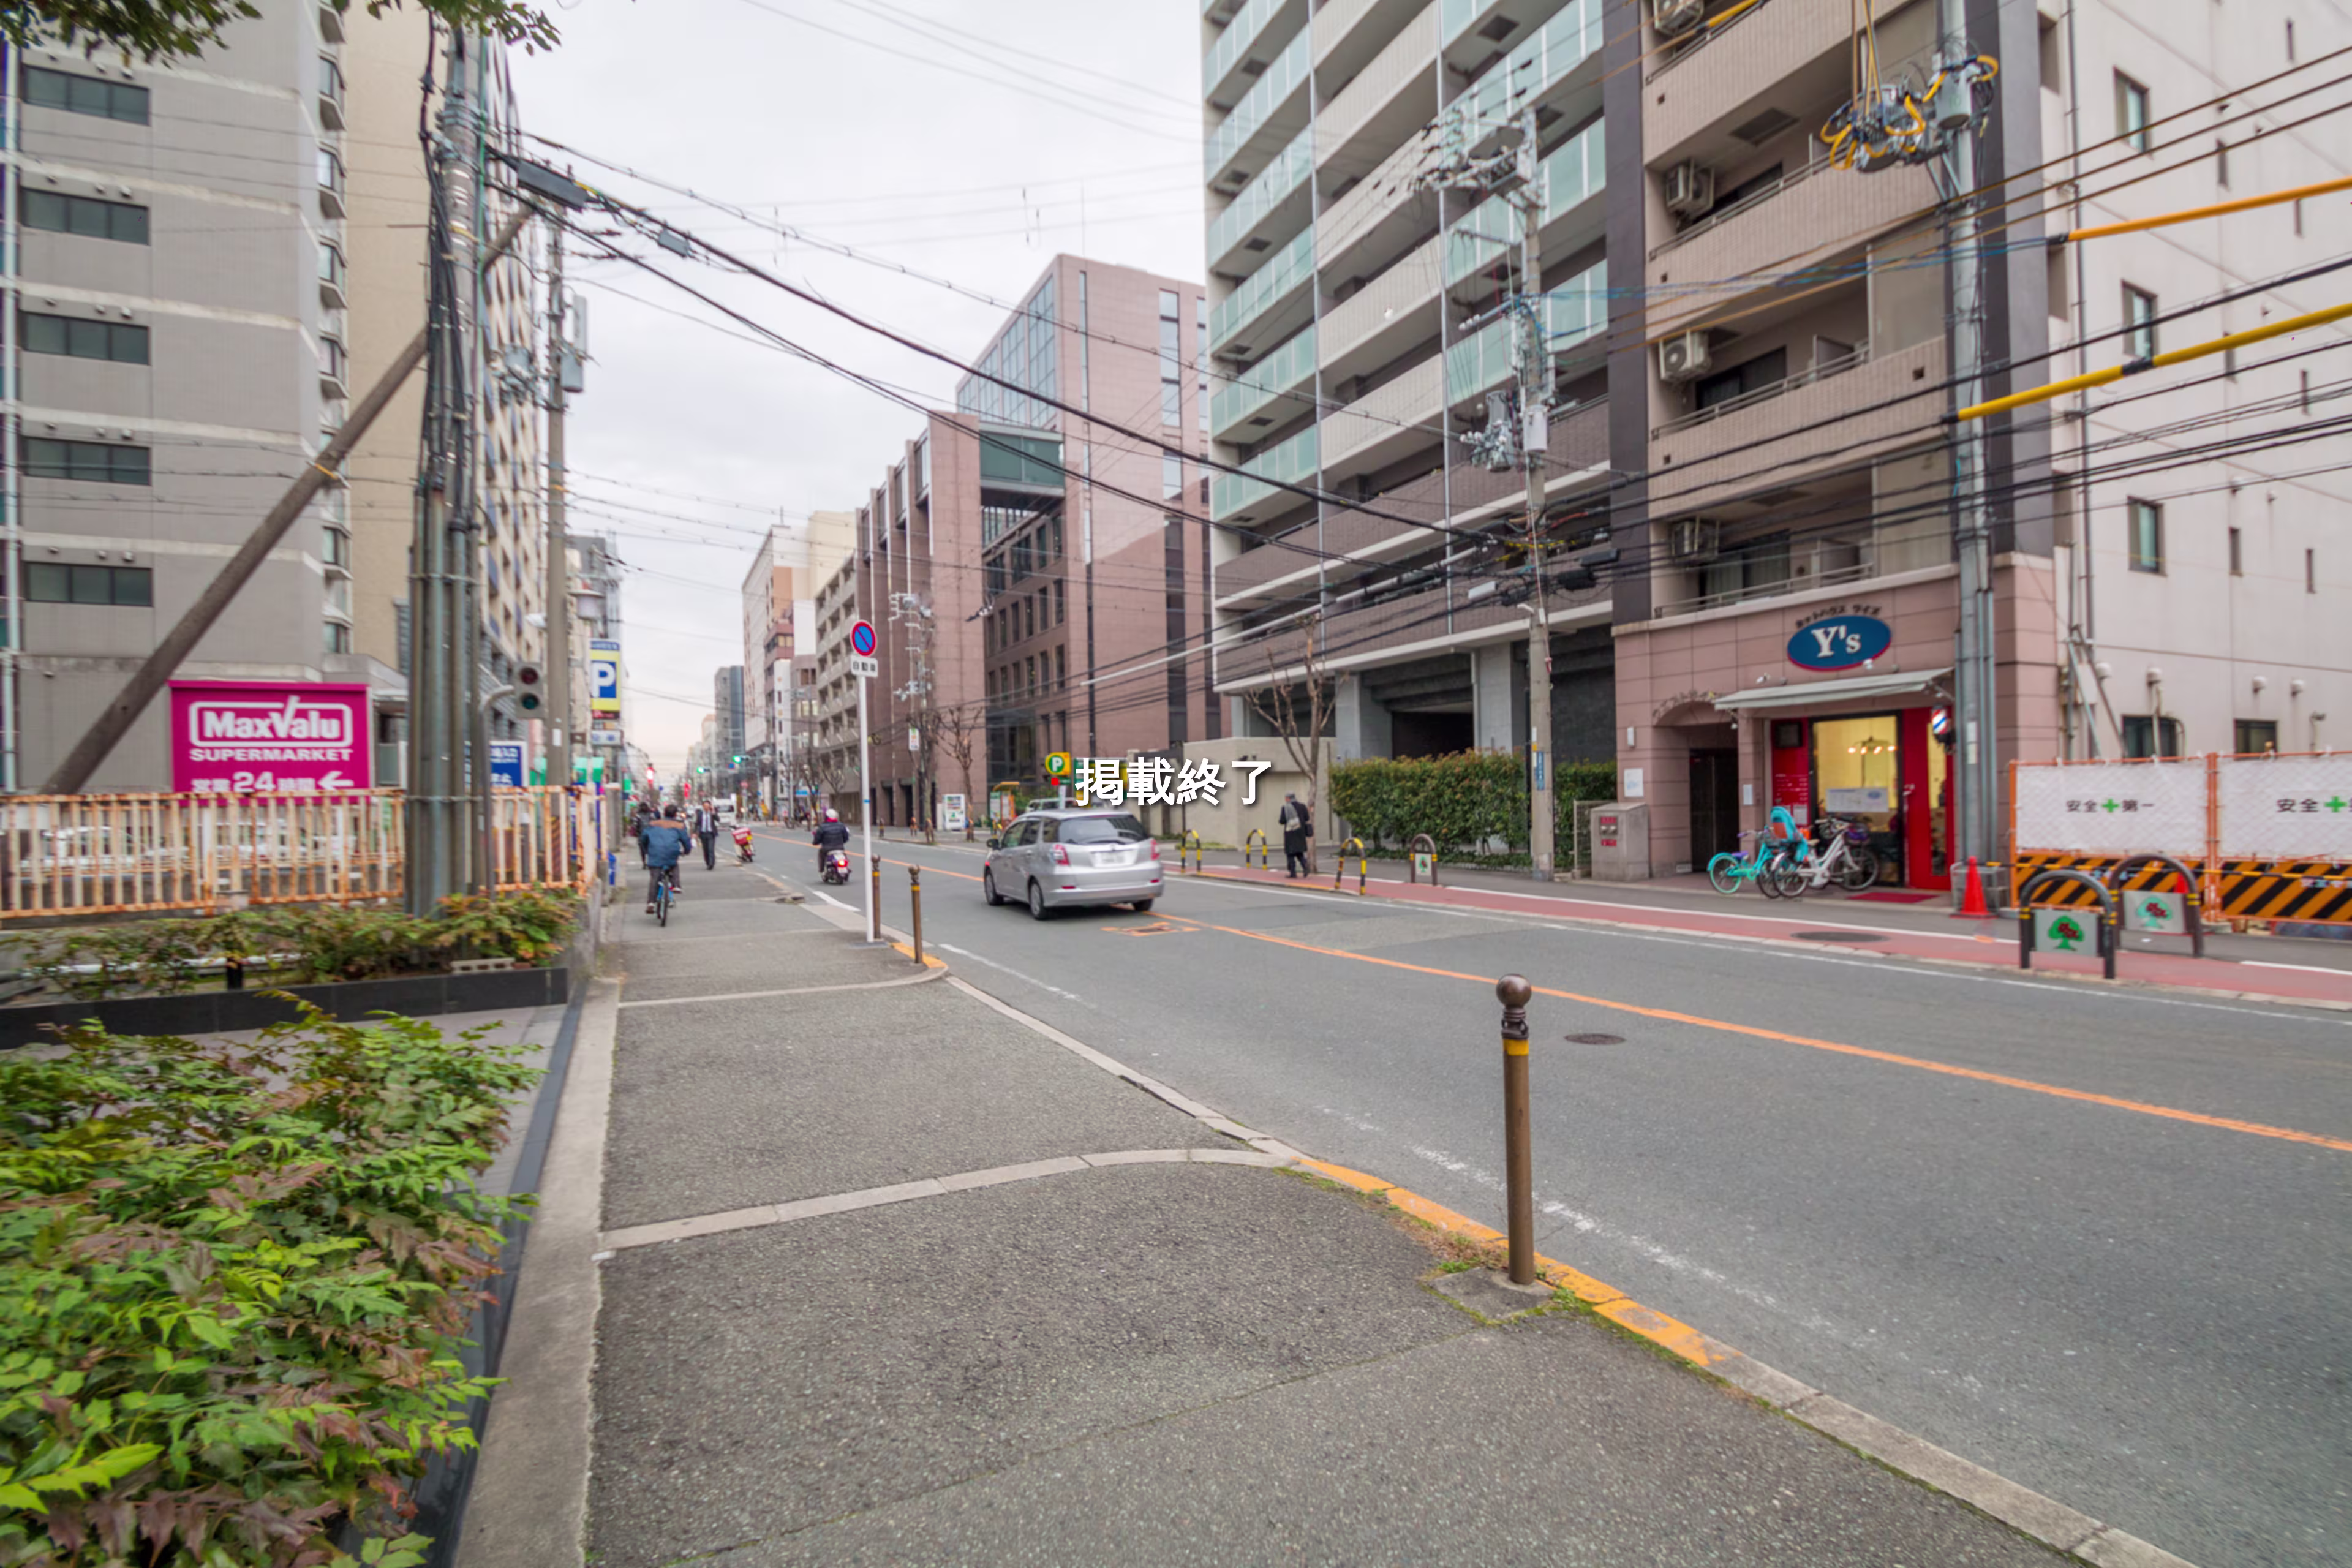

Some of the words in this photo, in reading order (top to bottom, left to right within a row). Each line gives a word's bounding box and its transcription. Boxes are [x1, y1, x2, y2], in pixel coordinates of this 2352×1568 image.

[1811, 624, 1861, 658] Y's
[853, 661, 876, 673] 自動車
[592, 662, 616, 698] P
[203, 695, 341, 739] MaxValu
[189, 748, 353, 761] SUPERMARKET
[1052, 756, 1063, 772] P
[2276, 798, 2320, 813] 安全
